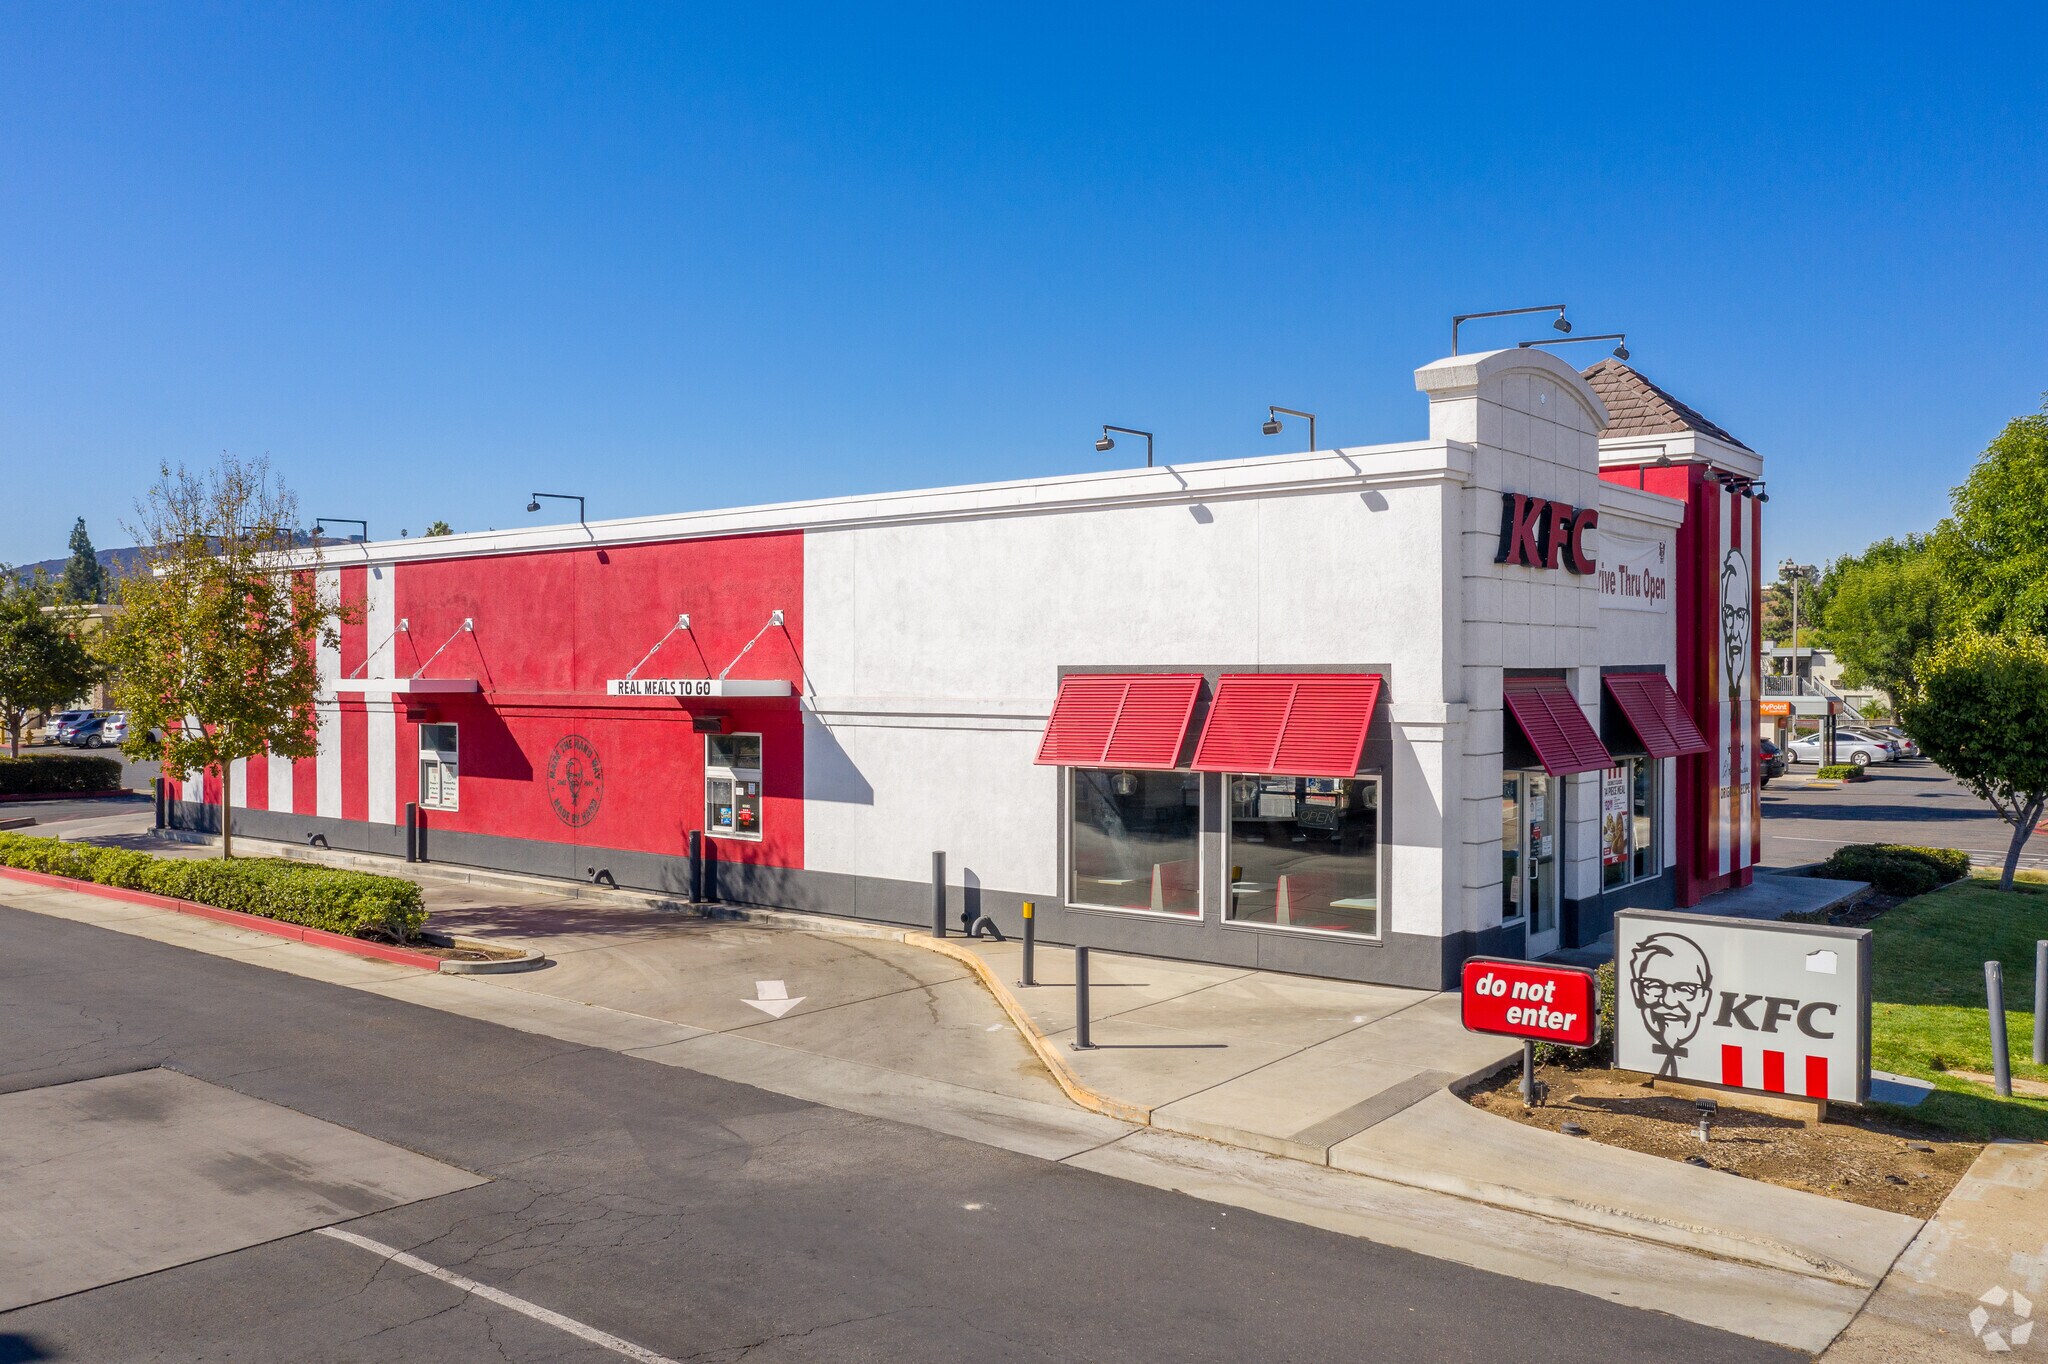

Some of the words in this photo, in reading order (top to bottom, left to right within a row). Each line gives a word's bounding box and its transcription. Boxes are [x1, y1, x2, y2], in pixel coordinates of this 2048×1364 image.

[1494, 492, 1599, 575] KFC
[1599, 562, 1616, 595] rive
[1619, 565, 1641, 598] Thru
[1643, 568, 1666, 606] Open
[618, 681, 642, 695] REAL
[644, 681, 676, 695] MEALS
[679, 681, 692, 695] TO
[695, 681, 711, 695] GO
[560, 739, 573, 753] THE
[574, 740, 593, 758] HARD
[592, 757, 601, 780] WAY
[554, 798, 570, 821] MADE
[1300, 810, 1336, 824] OPEN
[1476, 972, 1507, 998] do
[1511, 980, 1556, 1003] not
[1506, 1005, 1577, 1031] enter
[1713, 991, 1838, 1039] KFC
